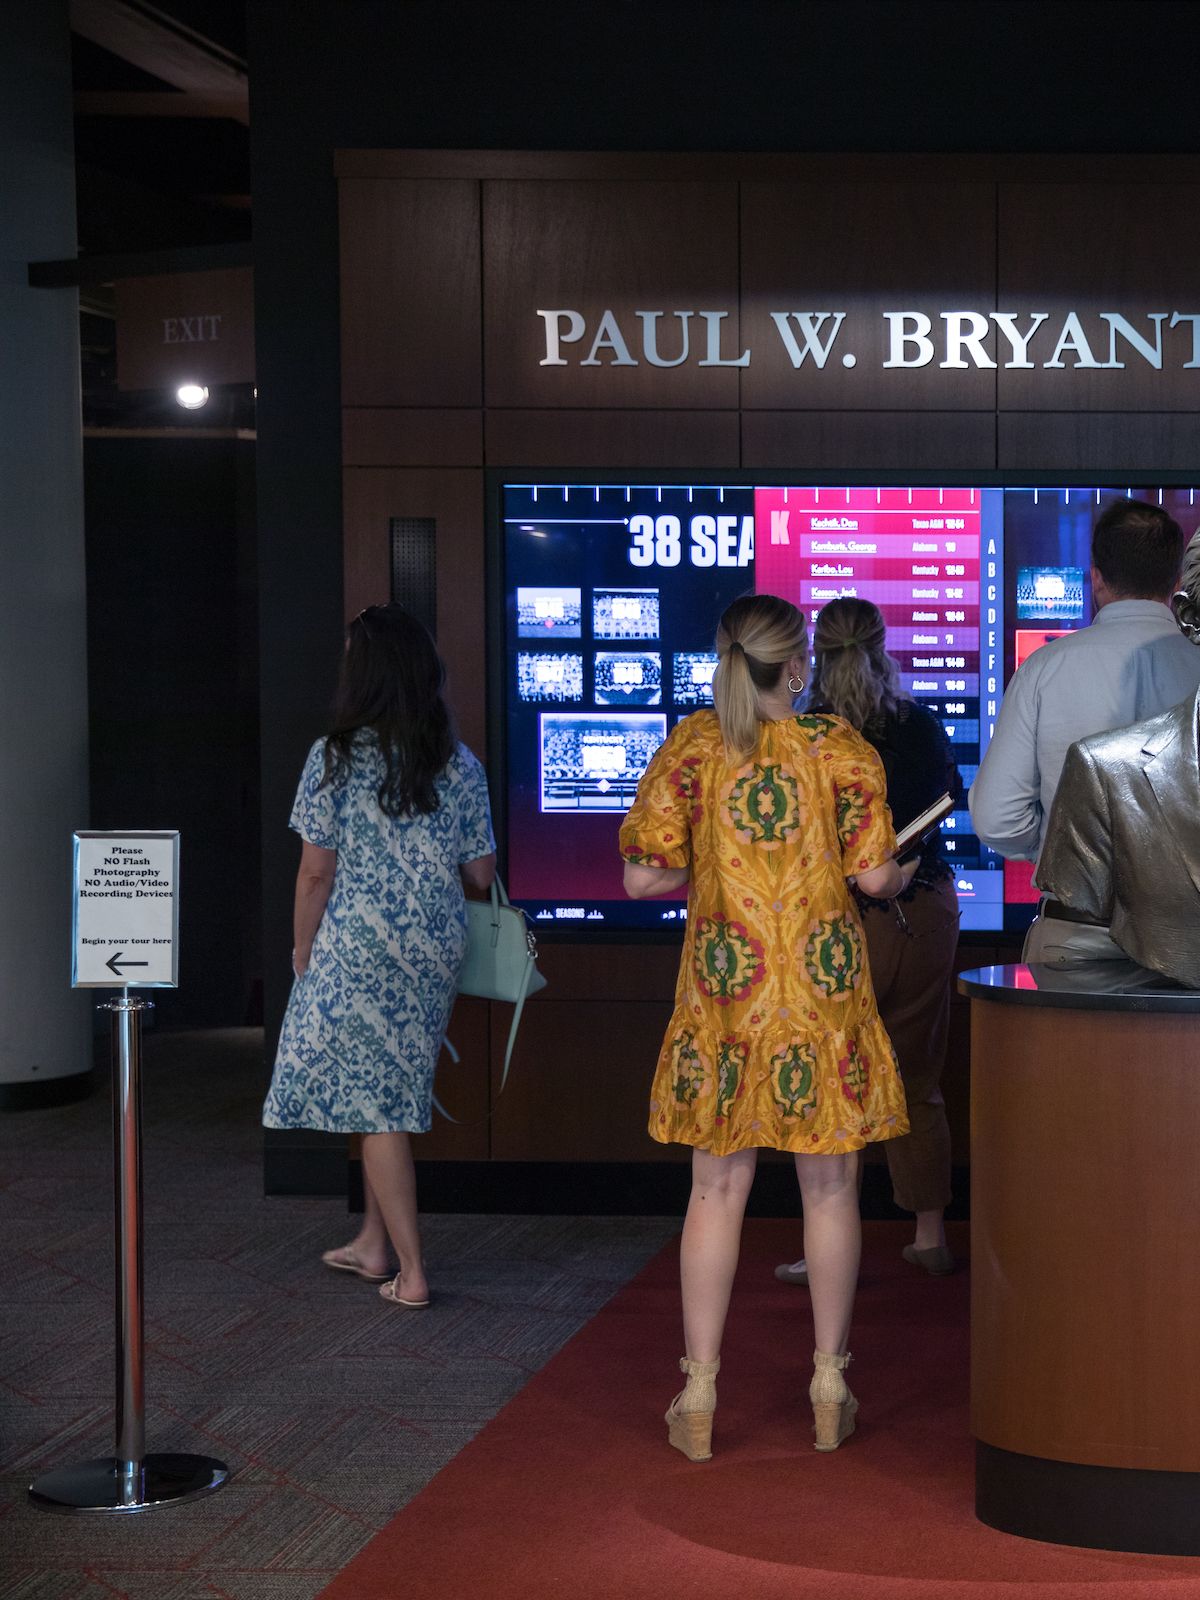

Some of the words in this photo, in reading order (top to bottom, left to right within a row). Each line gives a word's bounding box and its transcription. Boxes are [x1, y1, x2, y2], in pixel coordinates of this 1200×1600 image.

[162, 315, 222, 344] EXIT
[536, 309, 751, 368] PAUL
[770, 311, 857, 370] W.
[770, 511, 790, 544] K
[629, 515, 681, 567] 38
[691, 515, 755, 567] SEA
[912, 542, 938, 552] Alabama
[988, 539, 996, 554] A
[838, 564, 853, 574] Lou
[912, 565, 939, 576] Kentucky
[988, 562, 996, 577] B
[912, 588, 939, 598] Kentucky
[988, 585, 996, 600] C
[912, 611, 938, 621] Alabama
[987, 608, 996, 624] D
[912, 634, 938, 644] Alabama
[988, 631, 995, 647] E
[988, 654, 995, 670] F
[912, 680, 938, 690] Alabama
[987, 677, 996, 693] G
[987, 700, 996, 716] H
[112, 847, 143, 855] Please
[94, 868, 160, 877] Photography
[84, 879, 101, 887] NO
[104, 879, 169, 888] Audio/Video
[80, 890, 133, 898] Recording
[136, 890, 173, 898] Devices
[555, 908, 585, 918] SEASONS
